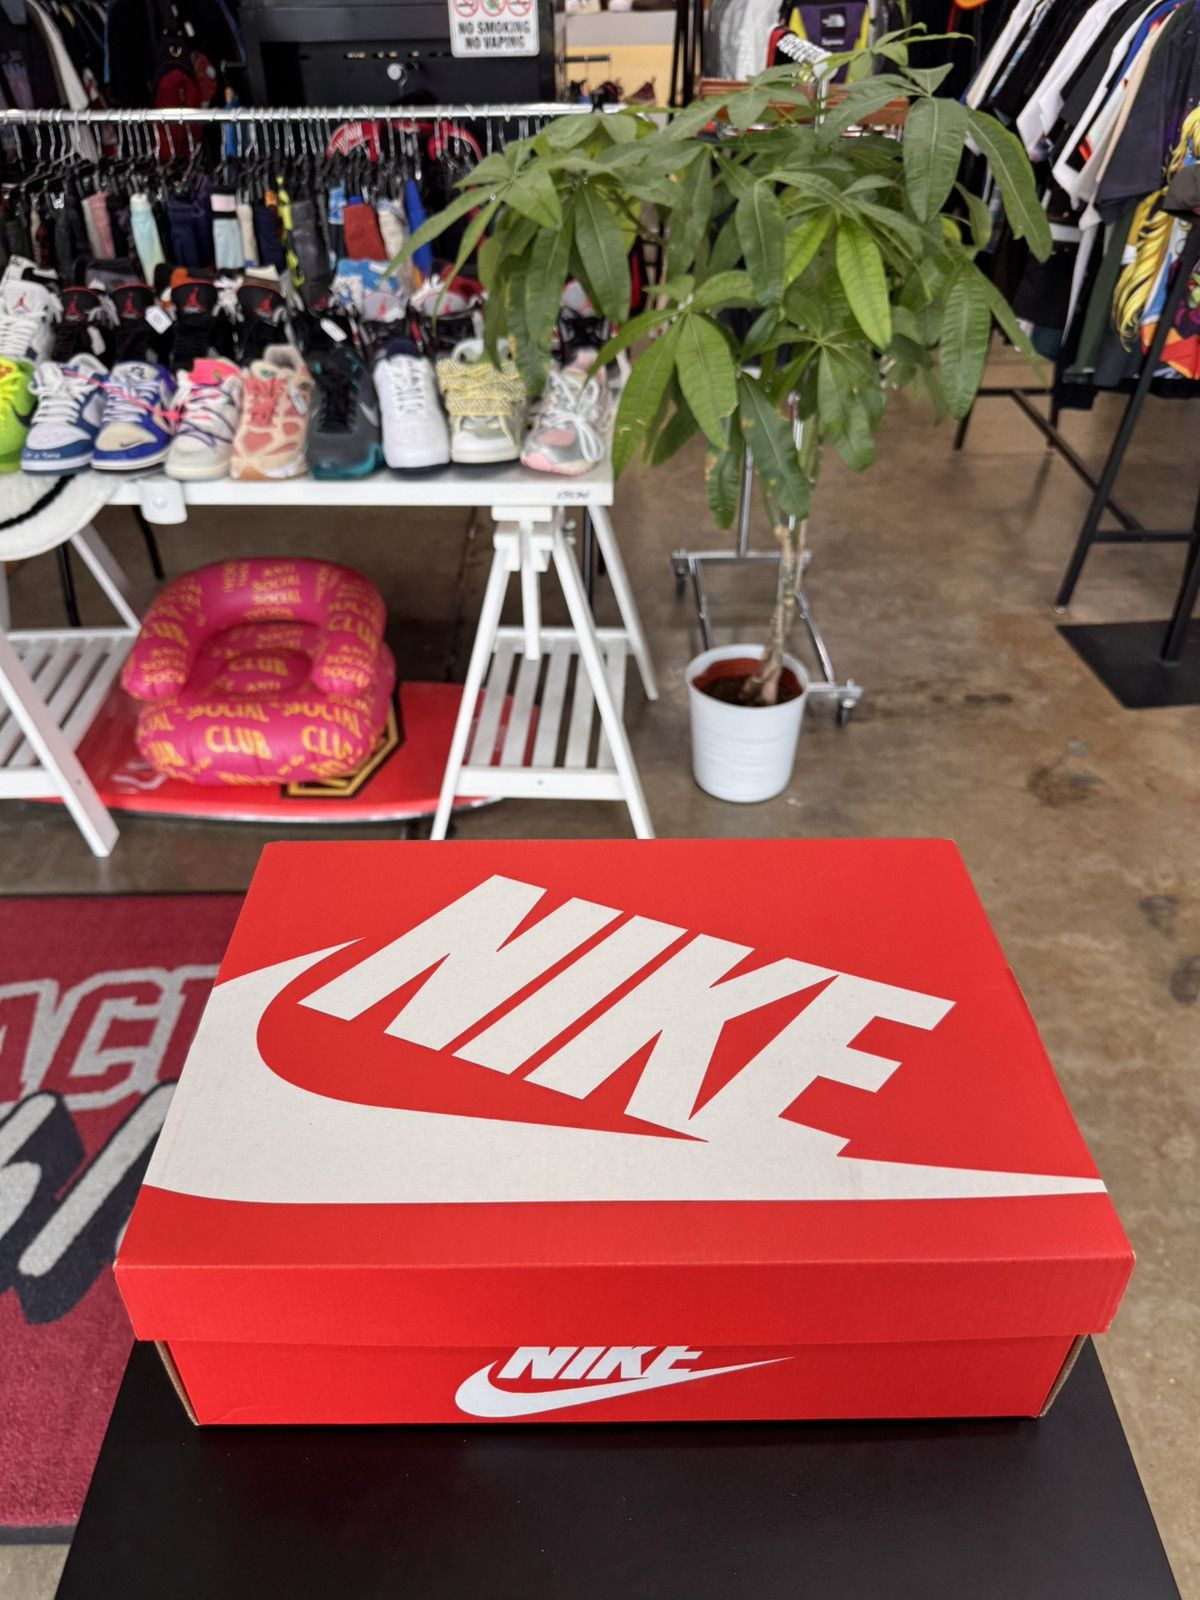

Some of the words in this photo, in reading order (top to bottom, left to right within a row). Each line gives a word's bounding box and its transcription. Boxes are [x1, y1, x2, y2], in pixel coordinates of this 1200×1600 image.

[458, 22, 474, 34] NO
[477, 21, 530, 34] SMOKING
[465, 37, 481, 49] NO
[483, 36, 526, 49] VAPING
[205, 725, 272, 760] CLUB
[297, 874, 957, 1157] NIKE
[497, 1345, 704, 1380] NIKE
